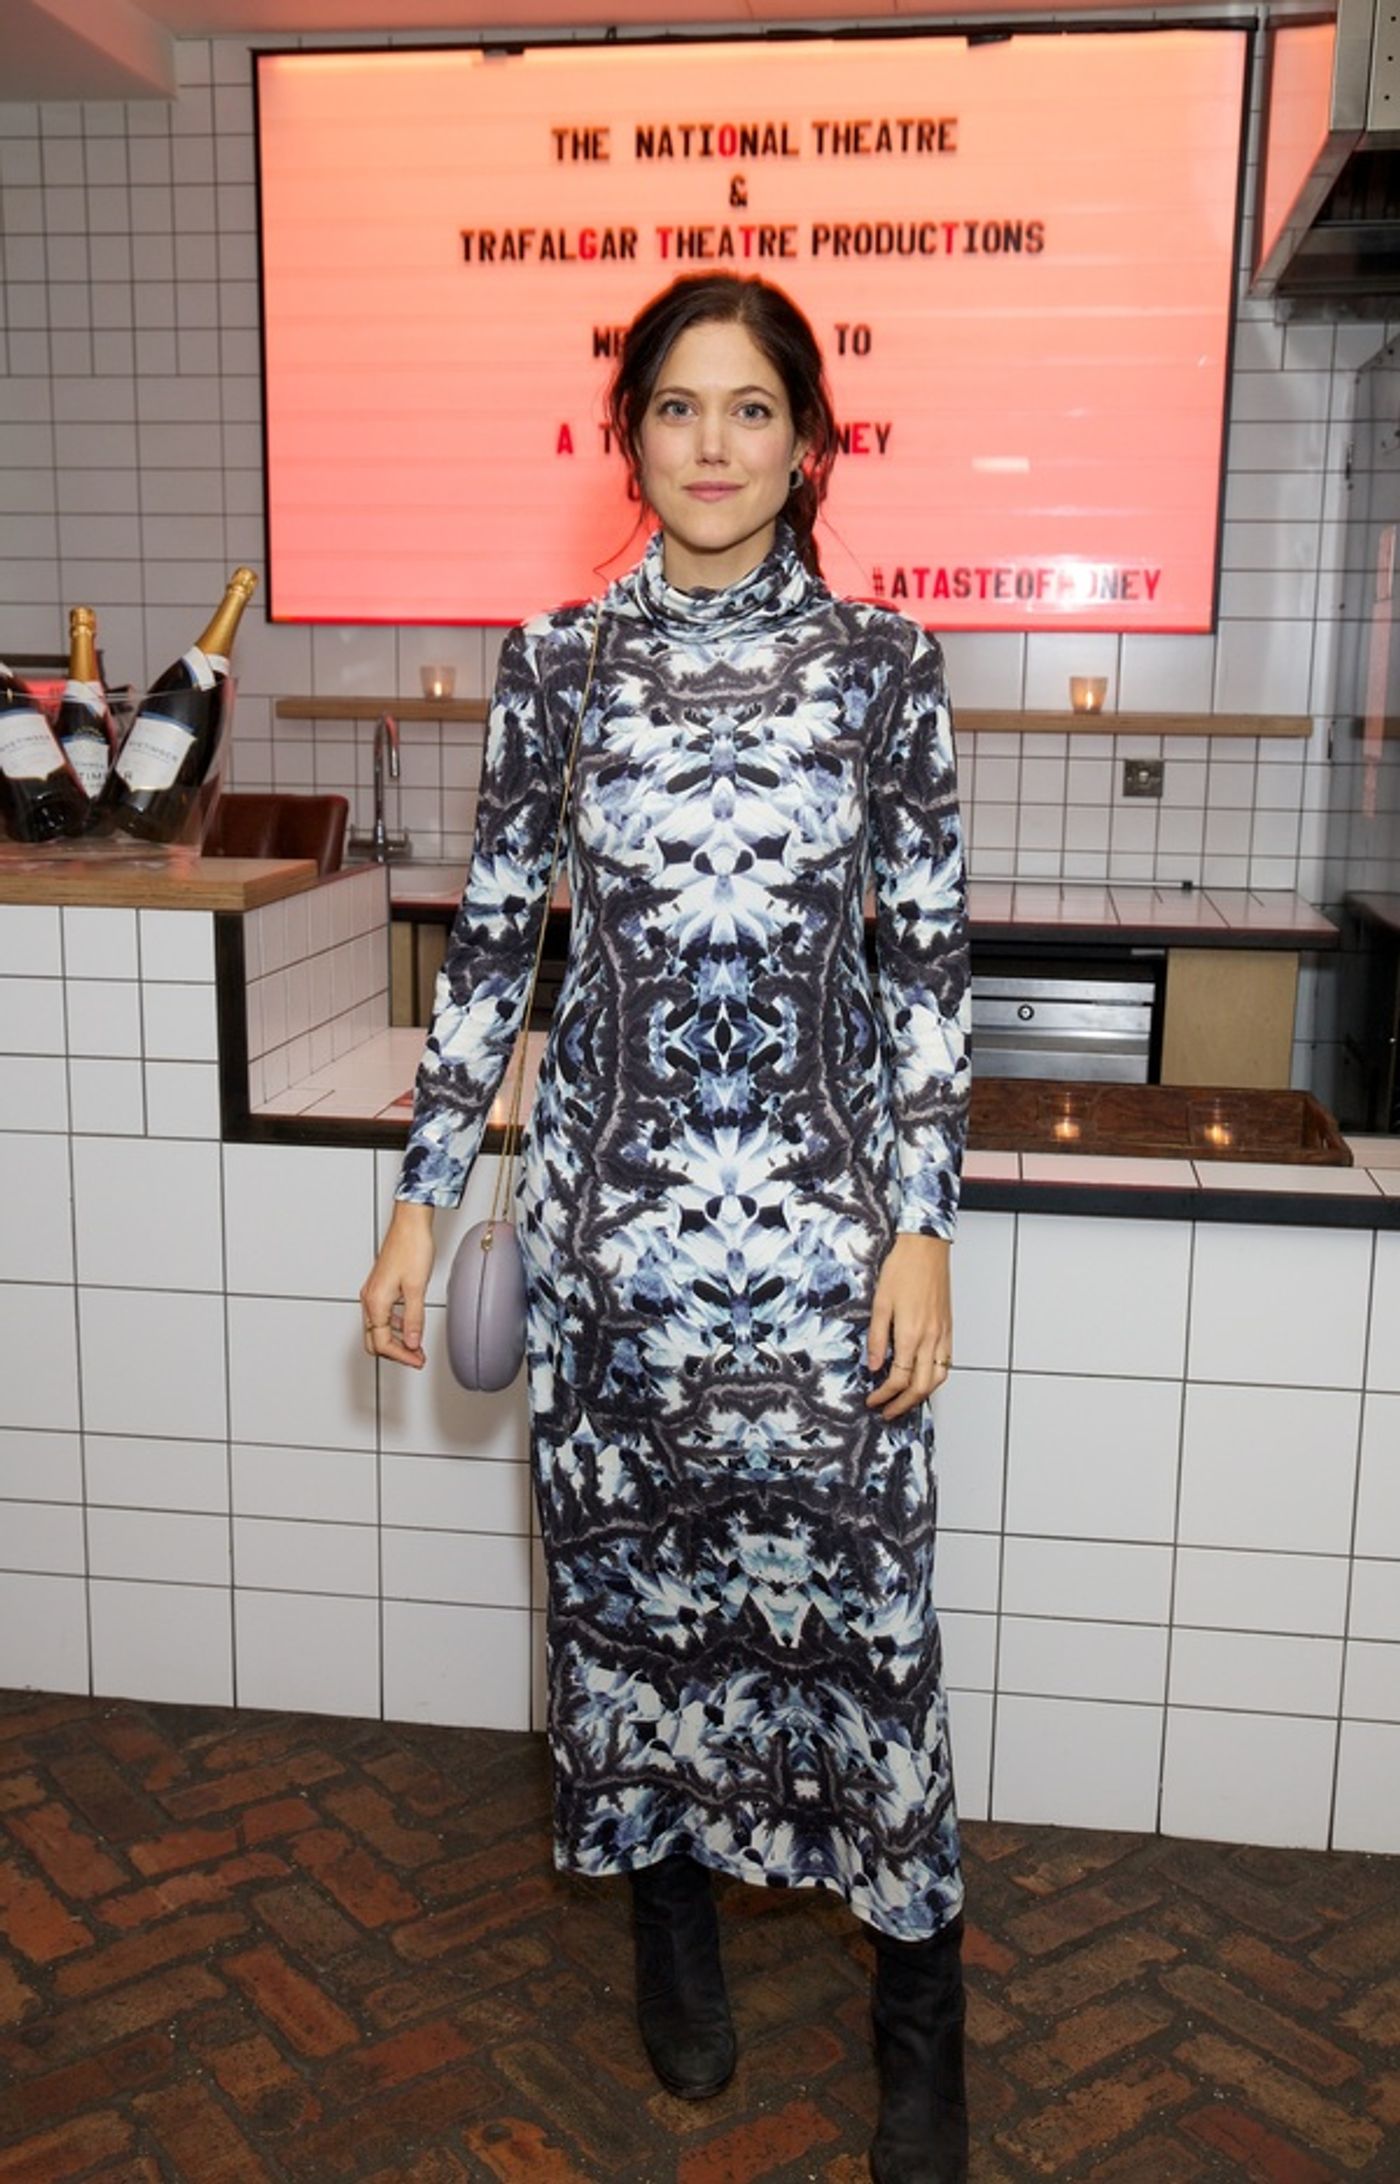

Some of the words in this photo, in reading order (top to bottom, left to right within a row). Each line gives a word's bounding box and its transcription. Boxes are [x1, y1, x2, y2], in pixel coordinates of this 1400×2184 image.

[551, 126, 610, 161] THE
[635, 121, 799, 159] NATIONAL
[811, 117, 958, 155] THEATRE
[729, 174, 748, 208] &
[460, 226, 639, 262] TRAFALGAR
[656, 224, 798, 259] THEATRE
[811, 220, 1046, 257] PRODUCTIONS
[835, 323, 871, 356] TO
[557, 422, 574, 455] A
